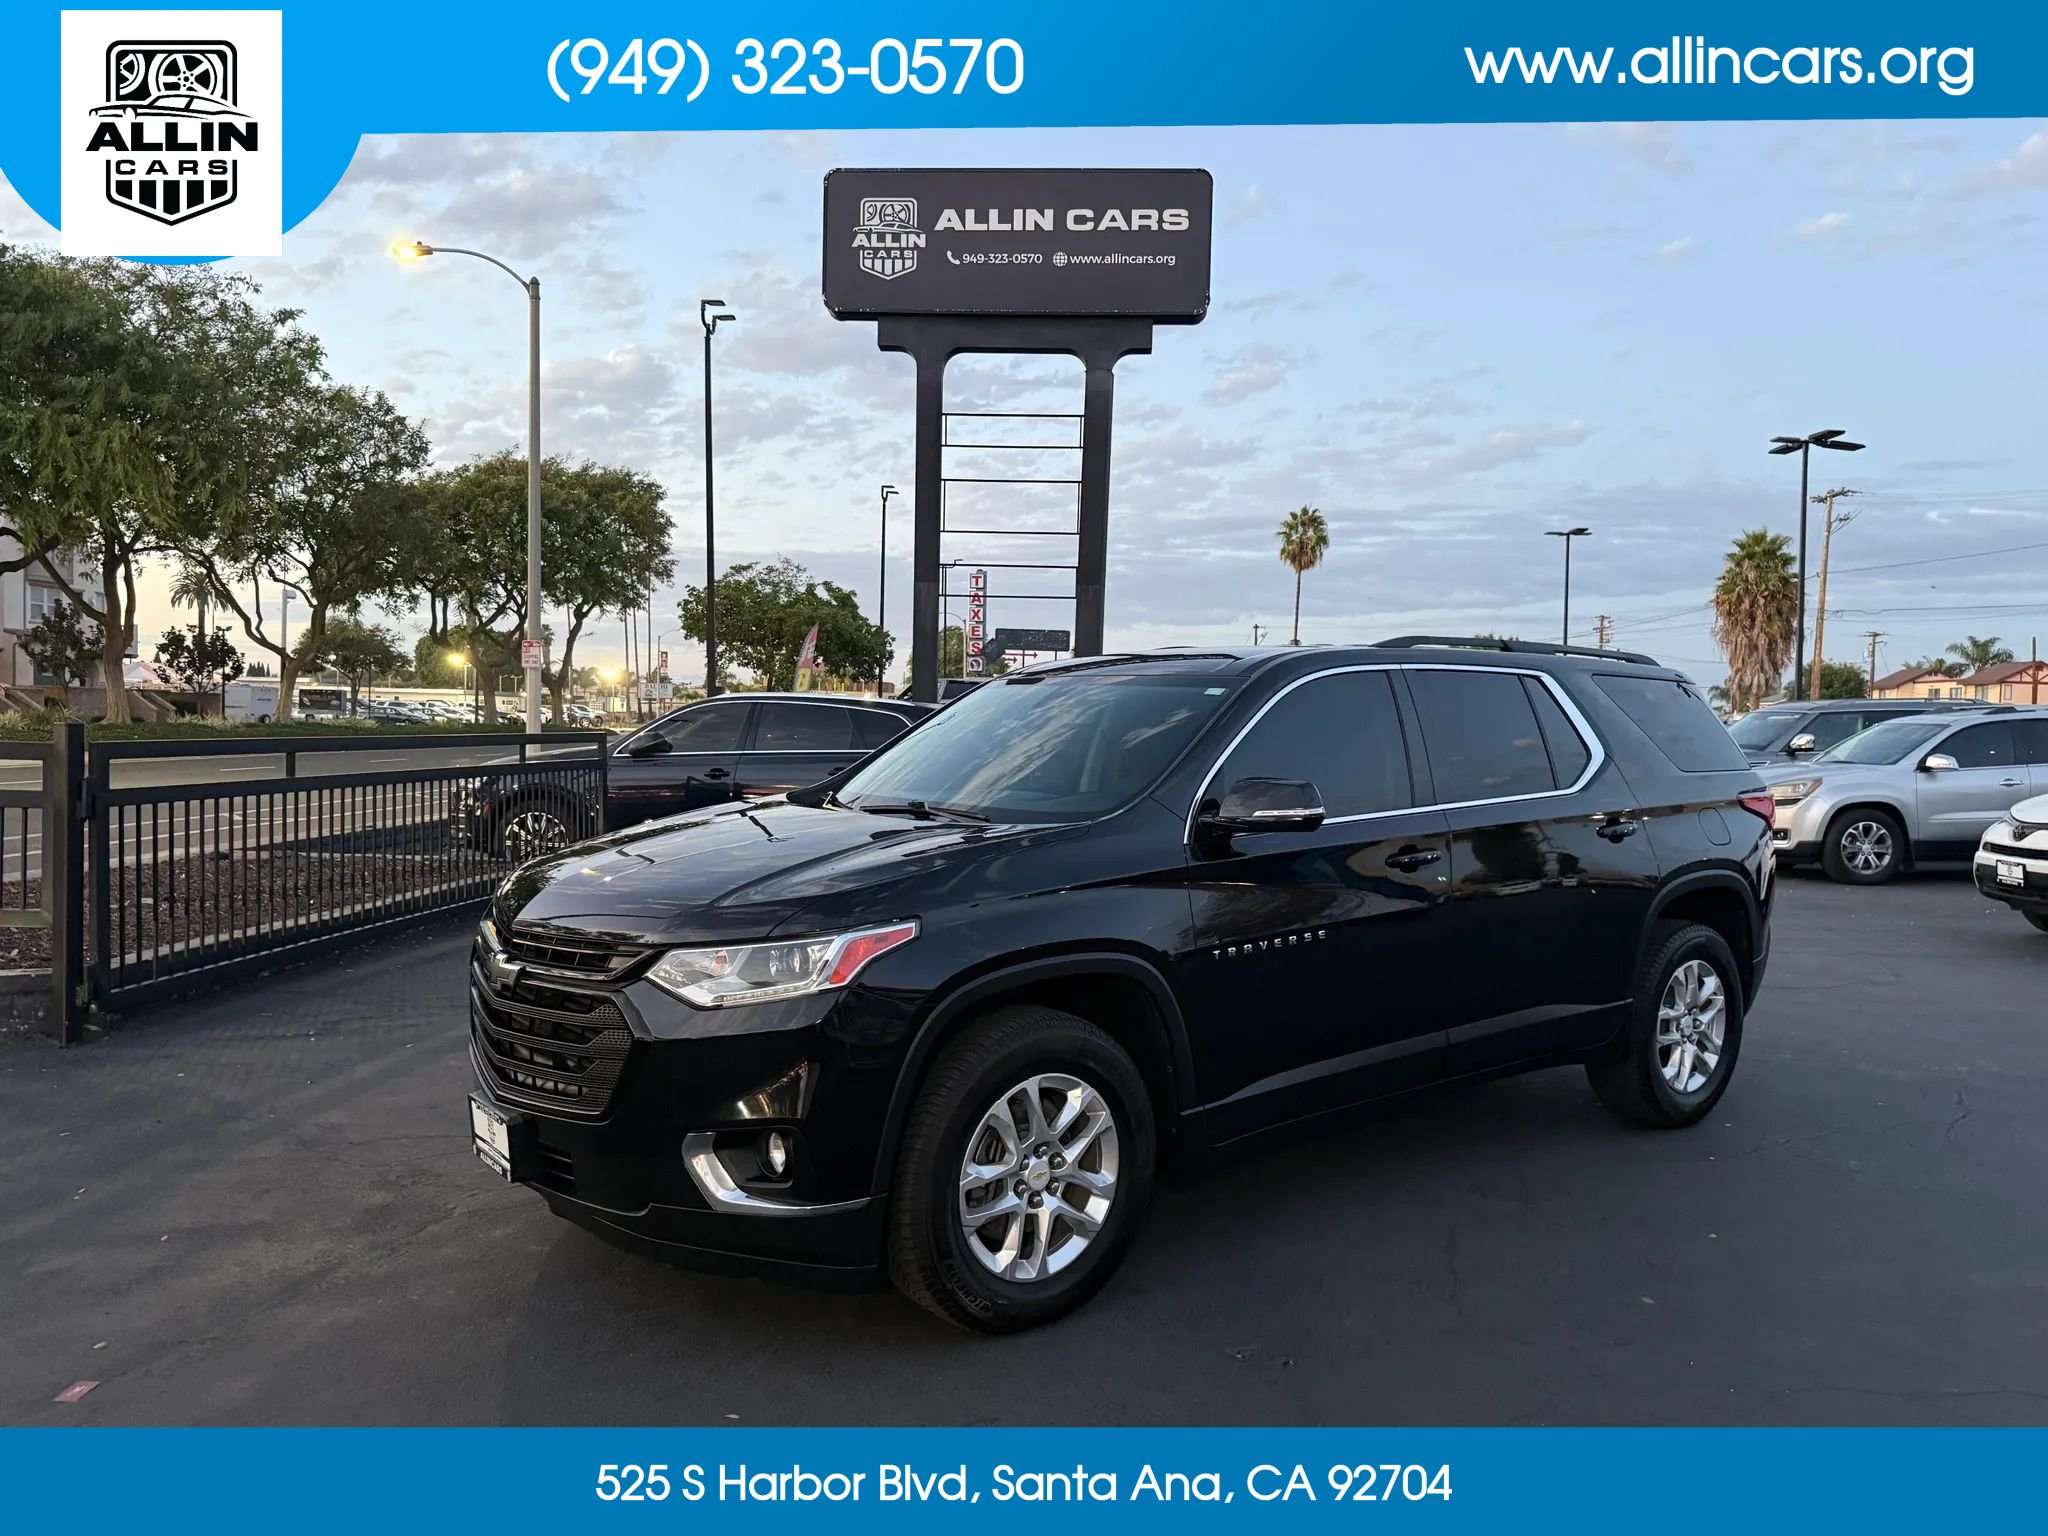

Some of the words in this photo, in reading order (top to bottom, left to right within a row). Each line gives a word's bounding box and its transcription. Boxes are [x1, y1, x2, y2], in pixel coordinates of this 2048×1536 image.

[934, 208, 1054, 231] ALLIN
[1067, 208, 1190, 231] CARS
[852, 233, 927, 248] ALLIN
[864, 249, 913, 258] CARS
[962, 253, 1043, 264] 949-323-0570
[1069, 252, 1176, 267] www.allincars.org
[971, 575, 983, 656] TAXES
[1212, 930, 1326, 959] TRAVERSE
